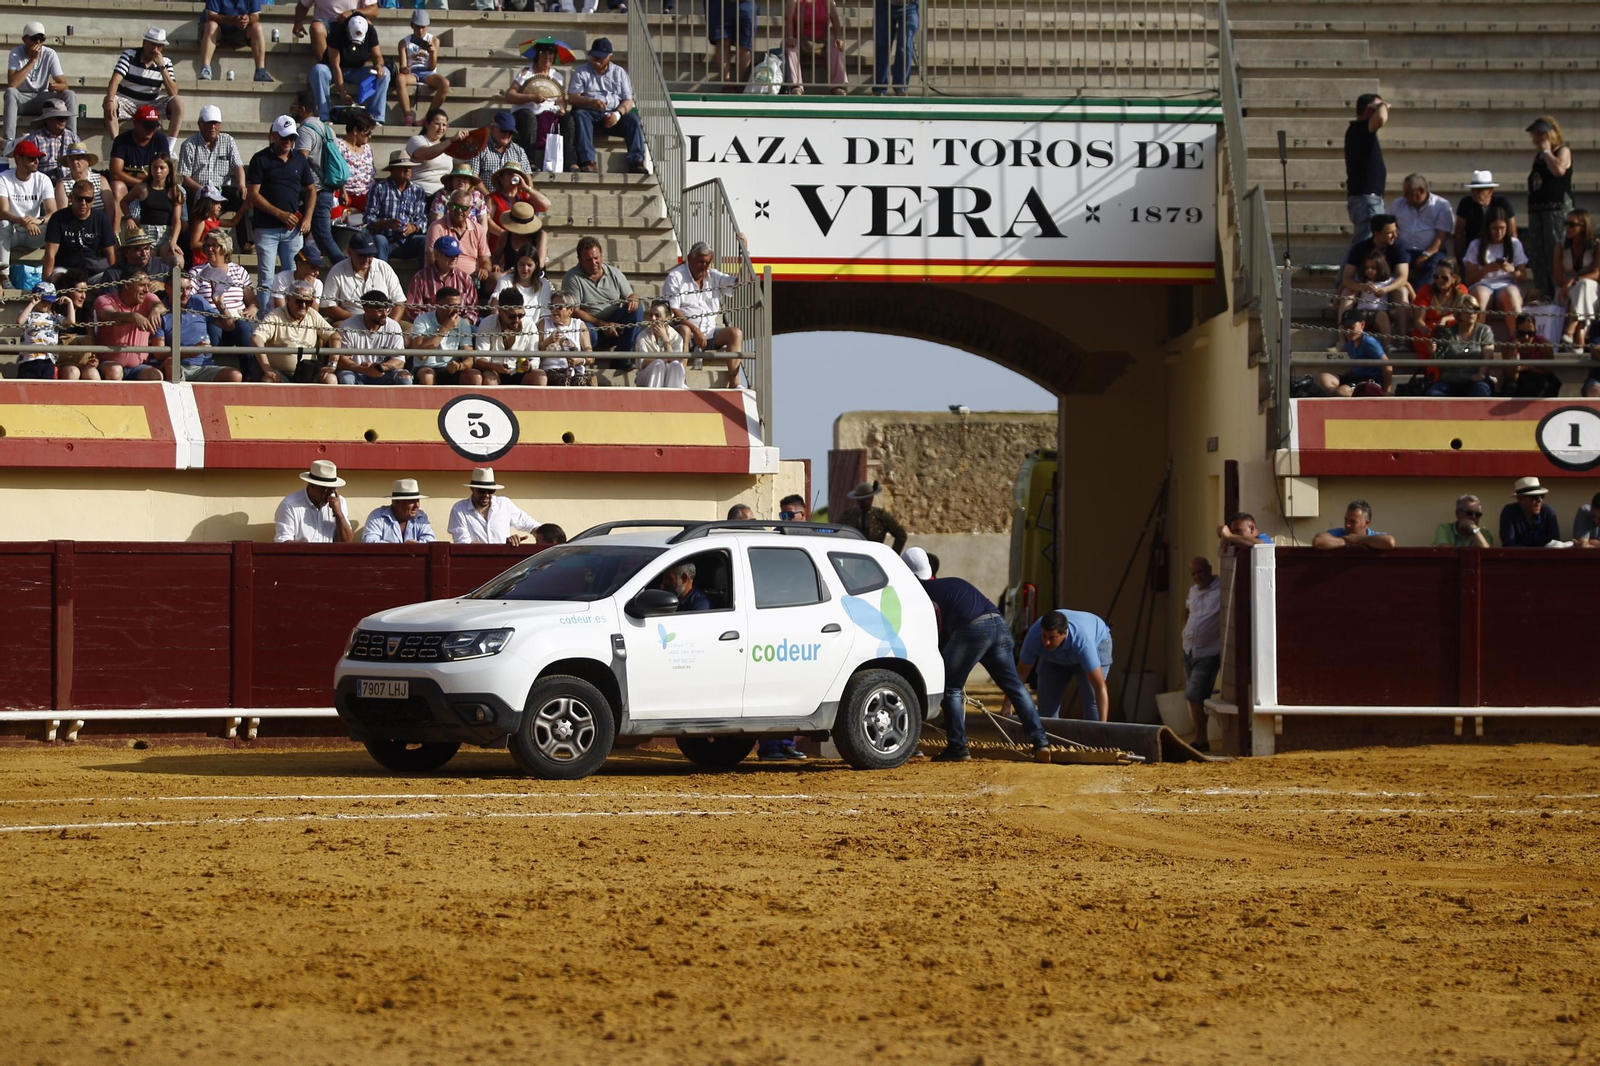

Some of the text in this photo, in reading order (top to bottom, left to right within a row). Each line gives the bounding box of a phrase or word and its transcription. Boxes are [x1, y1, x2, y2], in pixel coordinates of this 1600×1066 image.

[843, 137, 916, 166] DE
[932, 138, 1115, 169] TOROS
[1133, 141, 1206, 171] DE
[791, 184, 1069, 239] VERA
[1130, 206, 1204, 225] 1879
[467, 412, 491, 438] 5
[1567, 423, 1582, 447] 1
[559, 614, 607, 625] codeur.es
[752, 638, 822, 662] codeur
[363, 682, 407, 697] 7907 LHJ
